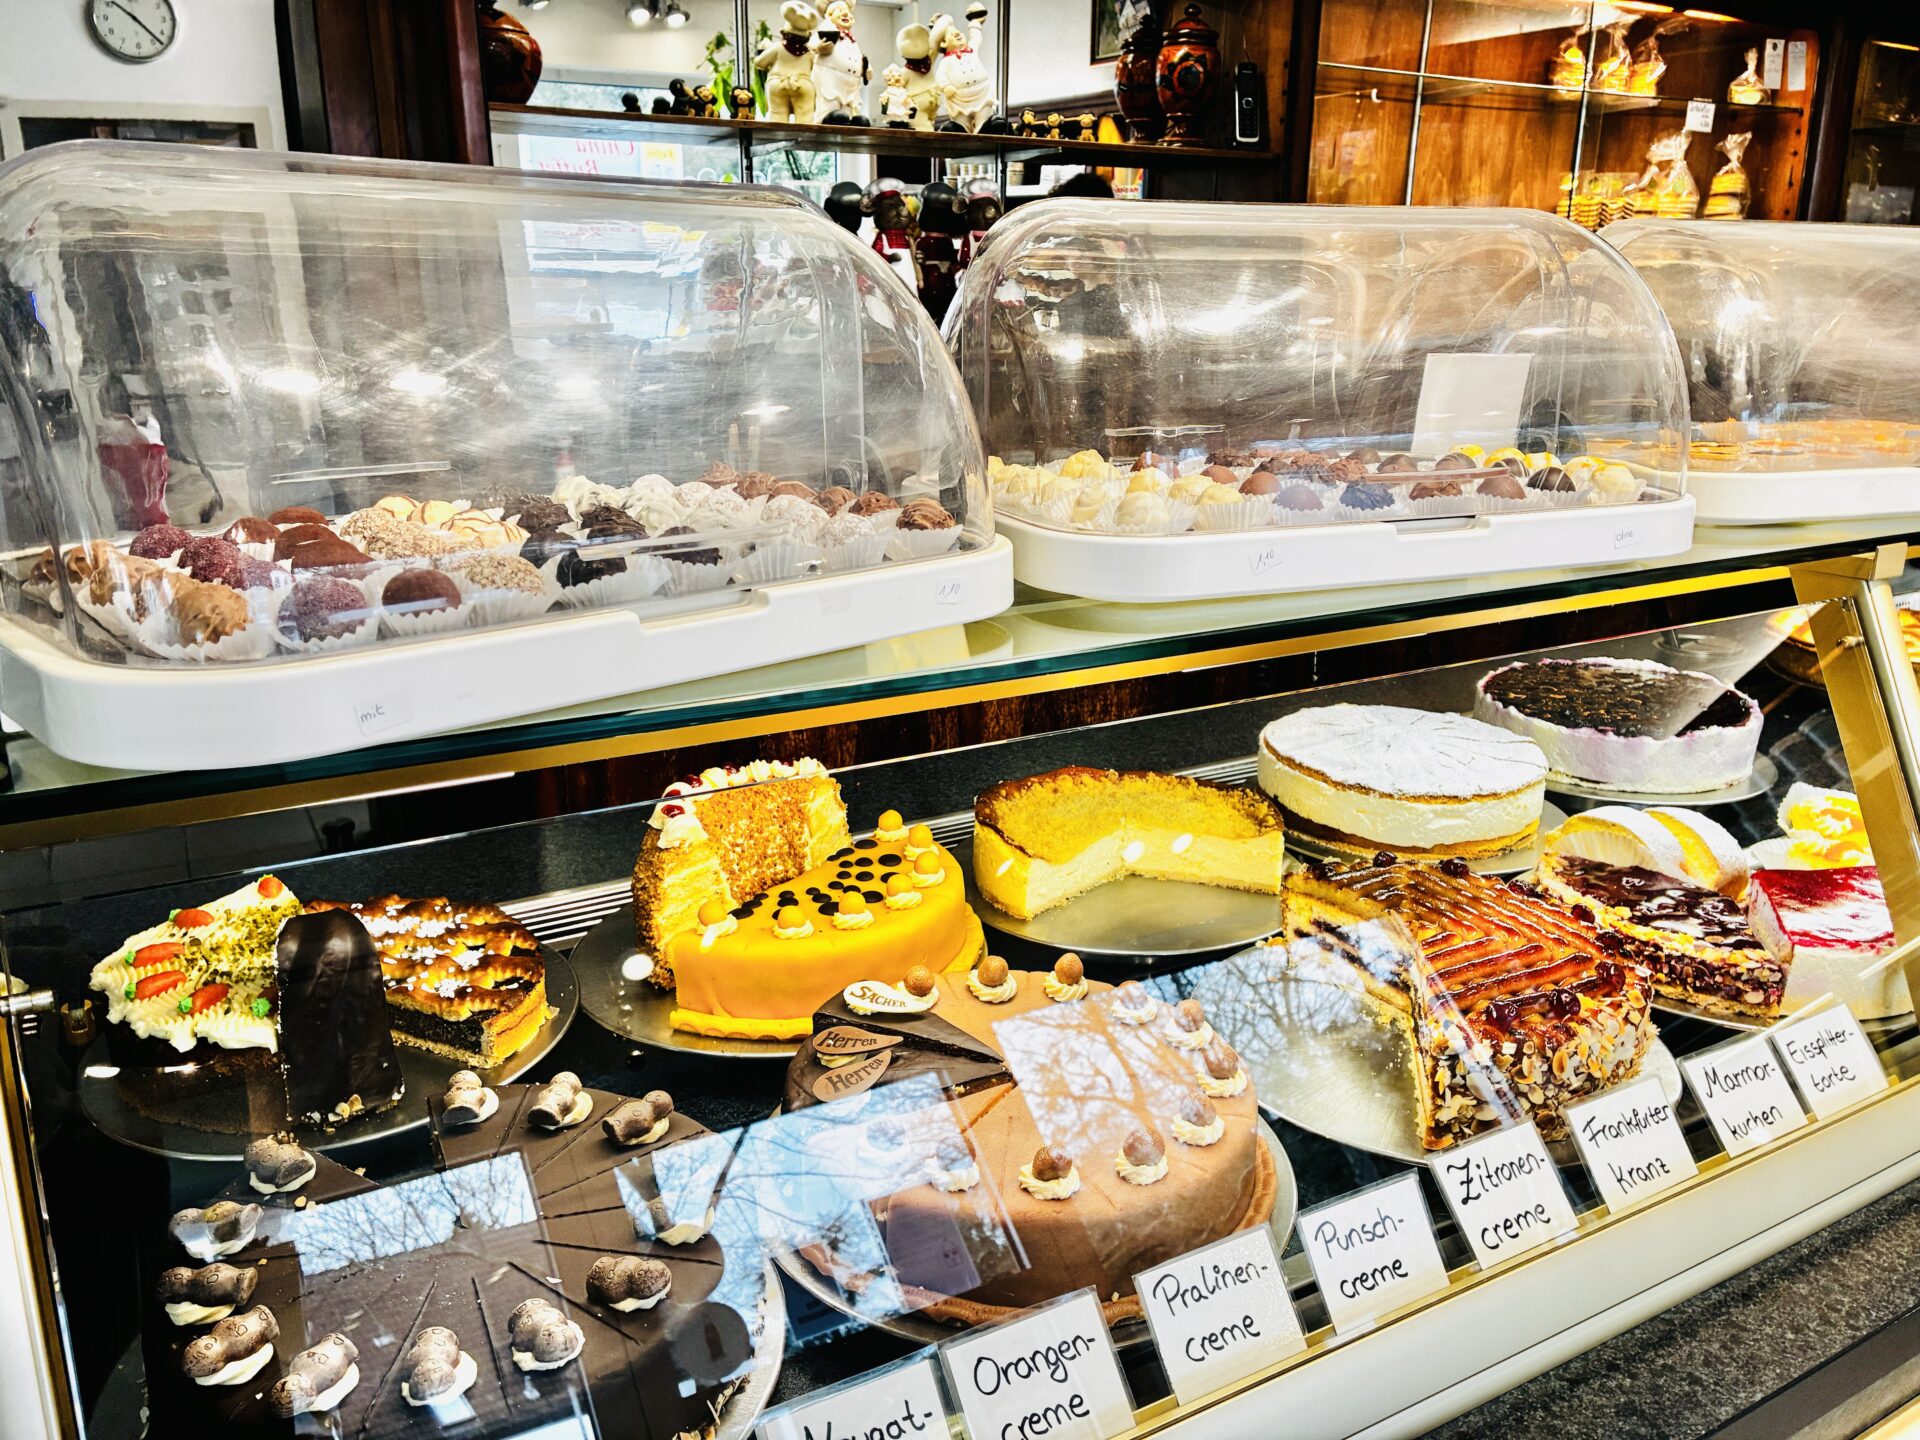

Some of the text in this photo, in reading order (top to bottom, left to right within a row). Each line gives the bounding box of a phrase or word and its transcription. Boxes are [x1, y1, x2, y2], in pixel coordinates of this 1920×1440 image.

[360, 703, 385, 723] mit
[849, 985, 908, 1008] SACHER
[816, 1030, 878, 1048] Herren
[824, 1057, 884, 1094] Herren
[1702, 1062, 1776, 1099] Marmor-
[1810, 1065, 1856, 1093] torte
[1582, 1104, 1670, 1149] Frankfurter
[1722, 1105, 1784, 1141] kuchen
[1446, 1152, 1545, 1206] Zitronen-
[1608, 1157, 1671, 1194] Kranz
[1314, 1207, 1405, 1259] Punsch-
[1480, 1203, 1551, 1250] creme
[1152, 1261, 1269, 1317] Pralinen-
[1339, 1258, 1409, 1299] creme
[1185, 1314, 1261, 1362] creme
[973, 1334, 1096, 1396] Orangen-
[1001, 1393, 1091, 1440] creme
